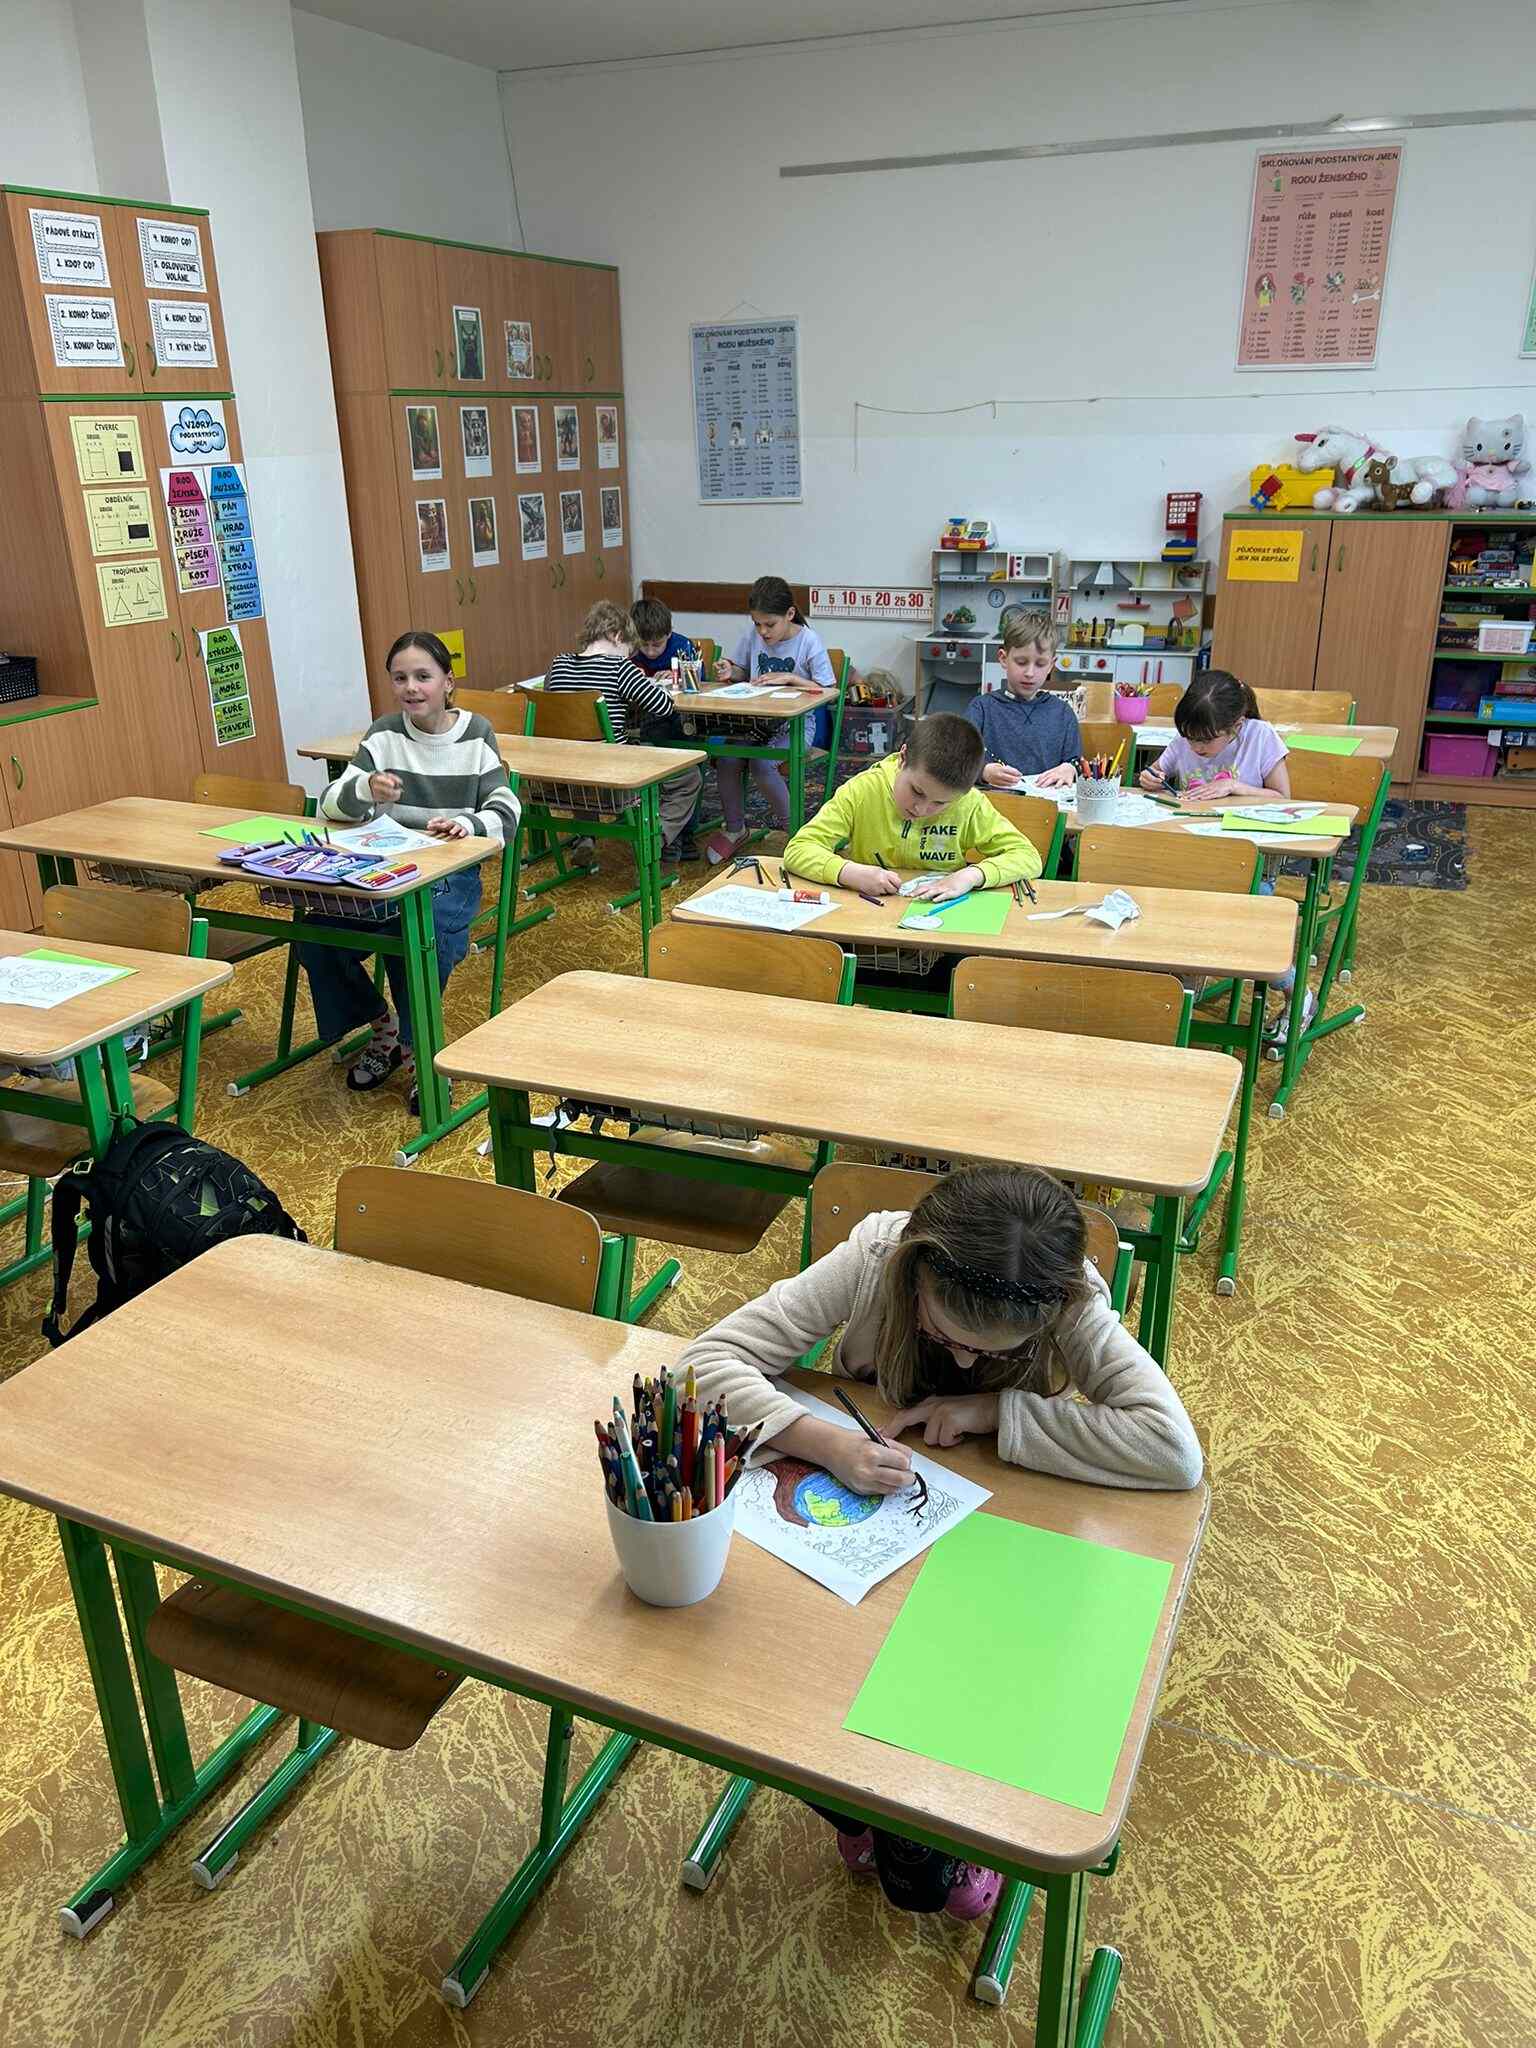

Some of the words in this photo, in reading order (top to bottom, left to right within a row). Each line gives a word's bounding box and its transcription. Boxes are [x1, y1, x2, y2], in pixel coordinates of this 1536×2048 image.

[1314, 153, 1374, 165] PODSTATNÝCH
[1376, 152, 1399, 161] JMEN
[1291, 175, 1316, 184] RODU
[1318, 171, 1368, 183] ŽENSKÉHO
[184, 420, 210, 429] VZORY
[221, 502, 238, 511] PÁN
[180, 508, 200, 518] ŽENA
[182, 527, 204, 538] RŮŽE
[222, 522, 245, 532] HRAD
[229, 542, 246, 553] MUŽ
[185, 548, 209, 560] PÍSEŇ
[227, 561, 252, 572] STROJ
[189, 570, 209, 580] KOST
[811, 590, 819, 604] 0
[829, 593, 835, 604] 5
[842, 591, 857, 605] 10
[861, 595, 871, 606] 15
[875, 592, 891, 606] 20
[895, 595, 906, 606] 25
[908, 592, 924, 607] 30
[214, 662, 240, 674] MĚSTO
[219, 680, 241, 695] MOŘE
[222, 702, 244, 715] KUŘE
[921, 825, 957, 835] TAKE
[919, 852, 956, 861] WAVE
